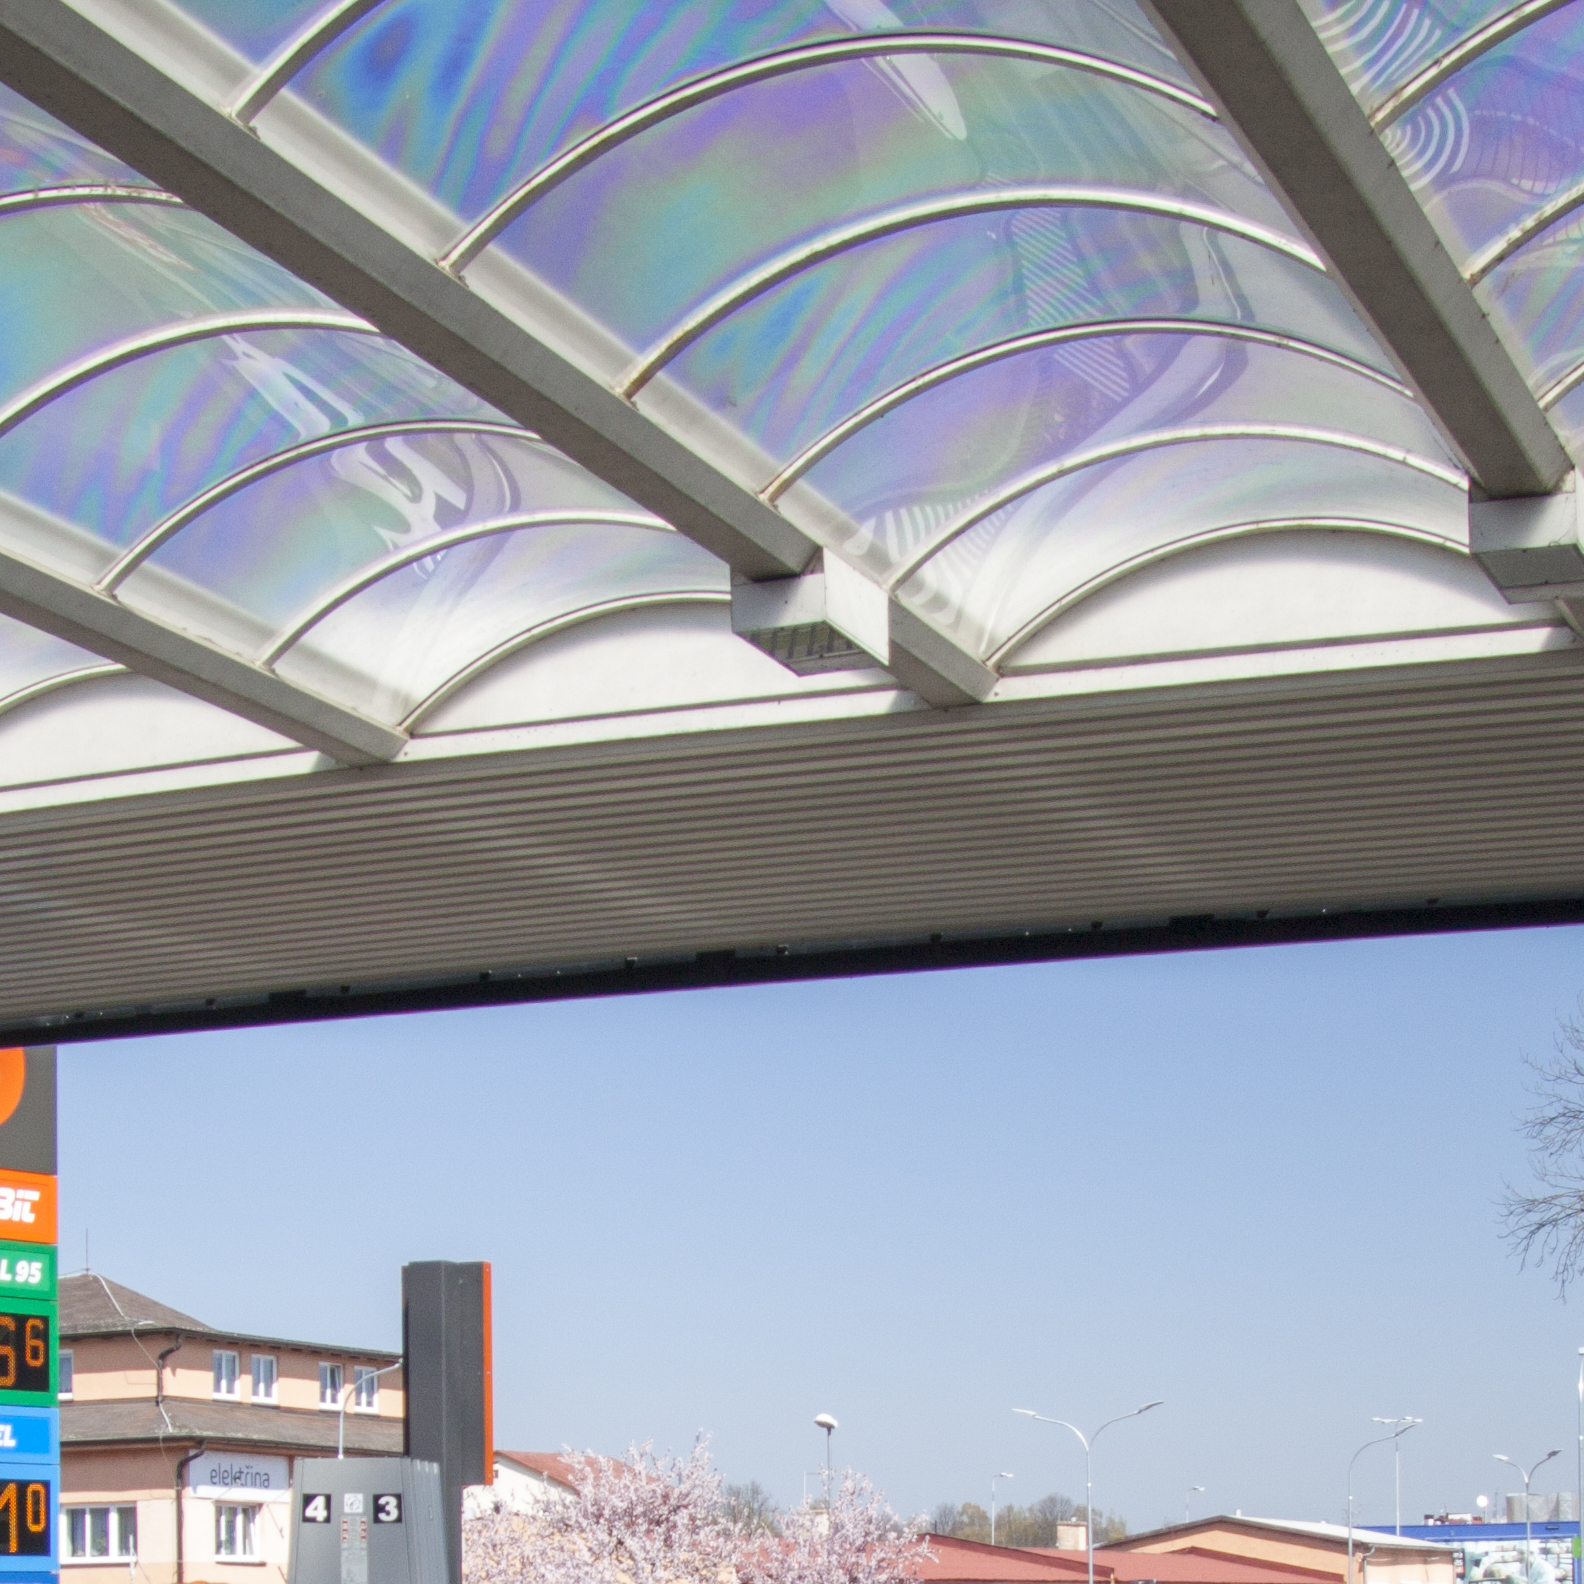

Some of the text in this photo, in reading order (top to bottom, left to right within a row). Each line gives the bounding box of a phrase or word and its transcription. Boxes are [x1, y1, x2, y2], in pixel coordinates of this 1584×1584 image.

[14, 1260, 43, 1284] 95
[304, 1495, 328, 1522] 4
[377, 1495, 399, 1522] 3
